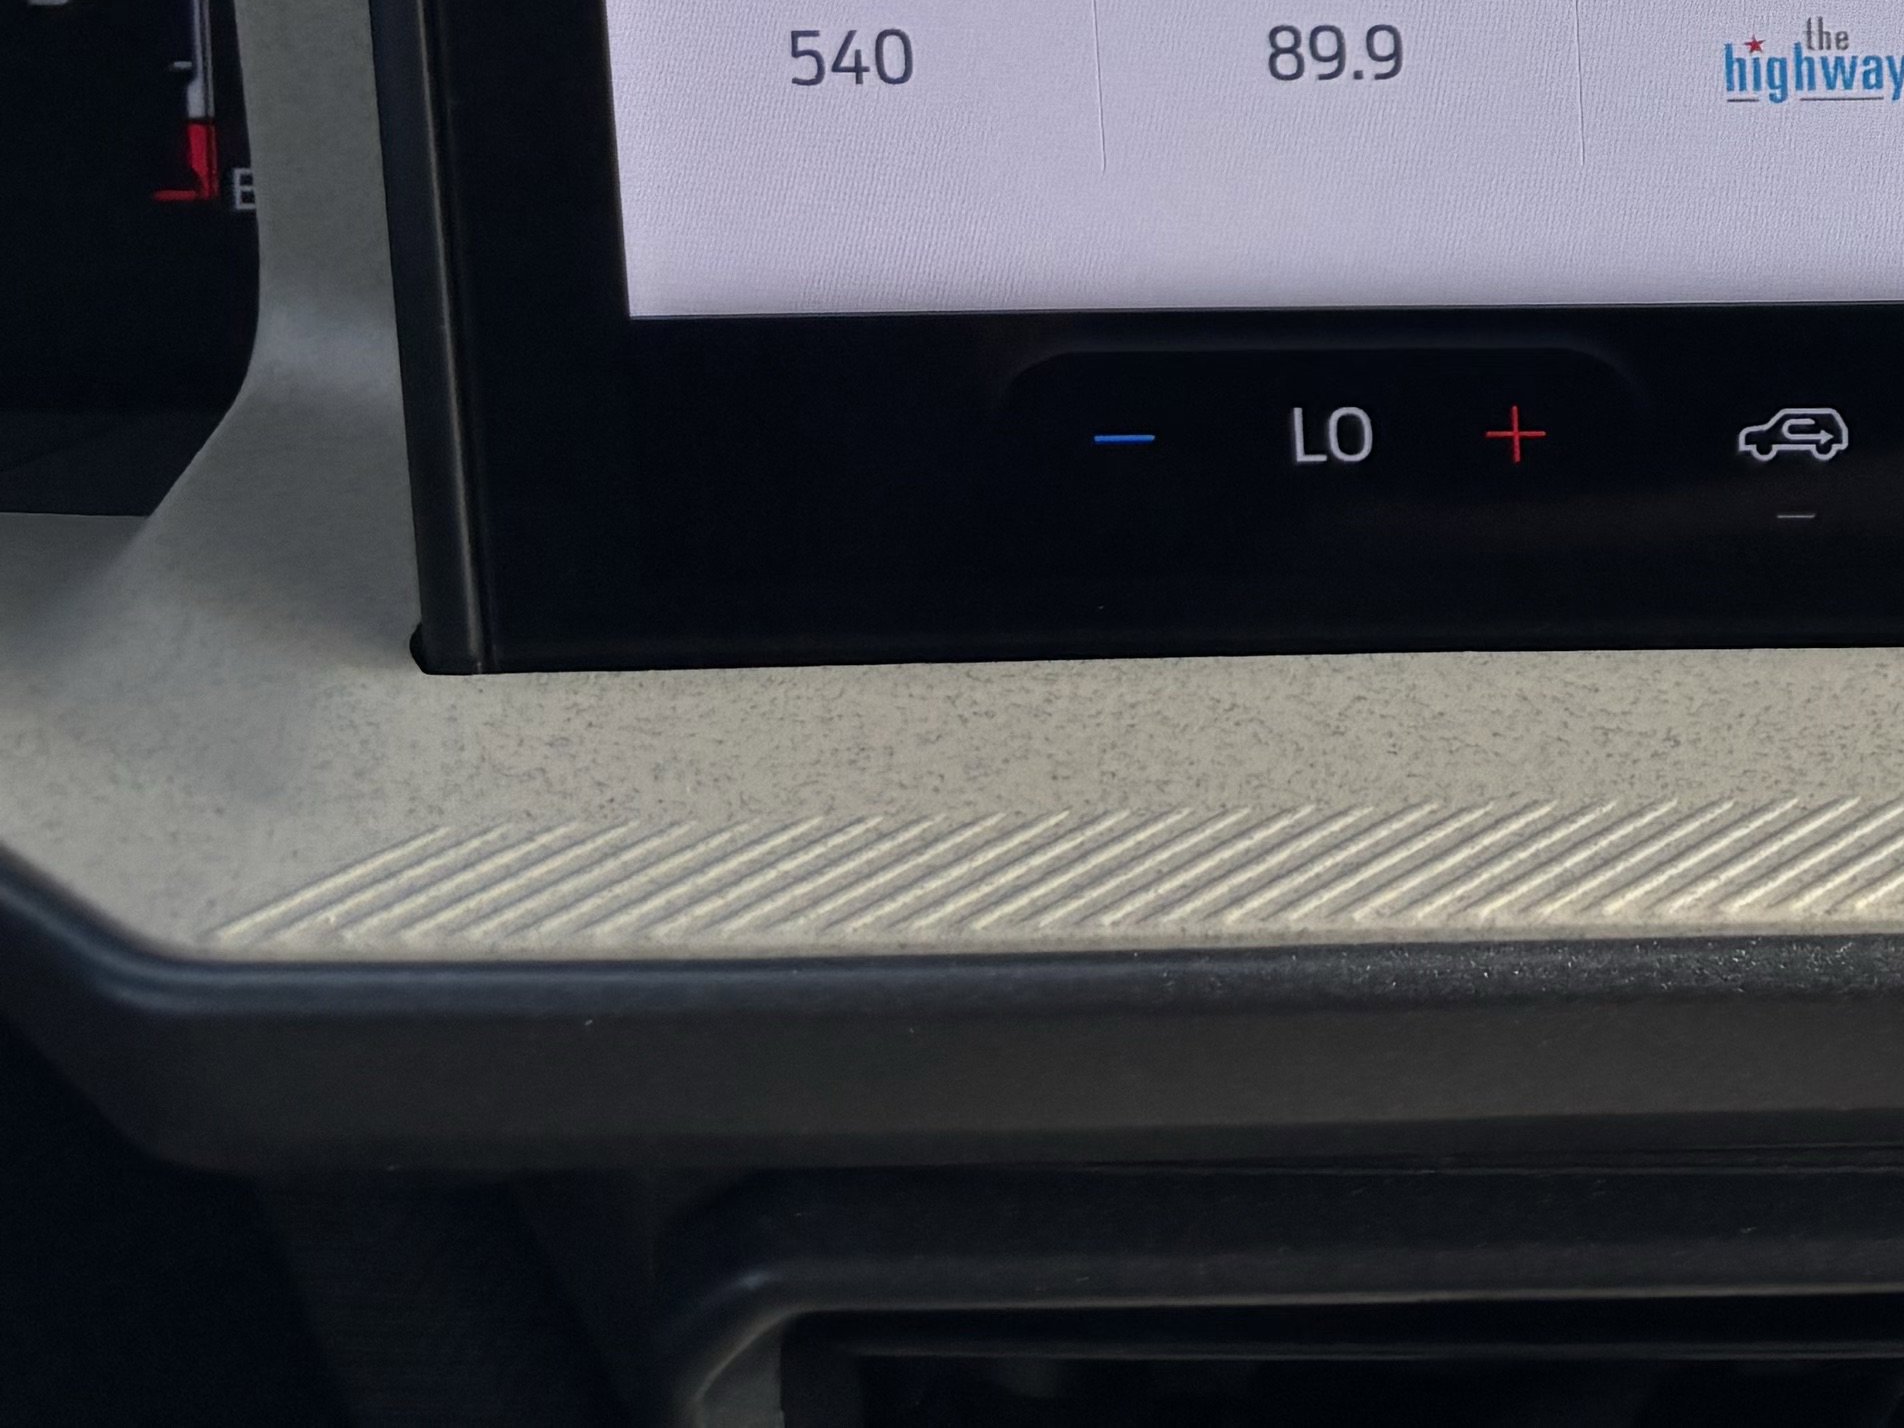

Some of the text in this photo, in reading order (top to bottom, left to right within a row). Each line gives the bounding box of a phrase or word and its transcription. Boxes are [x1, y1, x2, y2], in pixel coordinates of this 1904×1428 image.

[790, 28, 913, 87] 540
[1267, 23, 1403, 82] 89.9
[1804, 16, 1850, 51] the
[1292, 406, 1373, 464] LO
